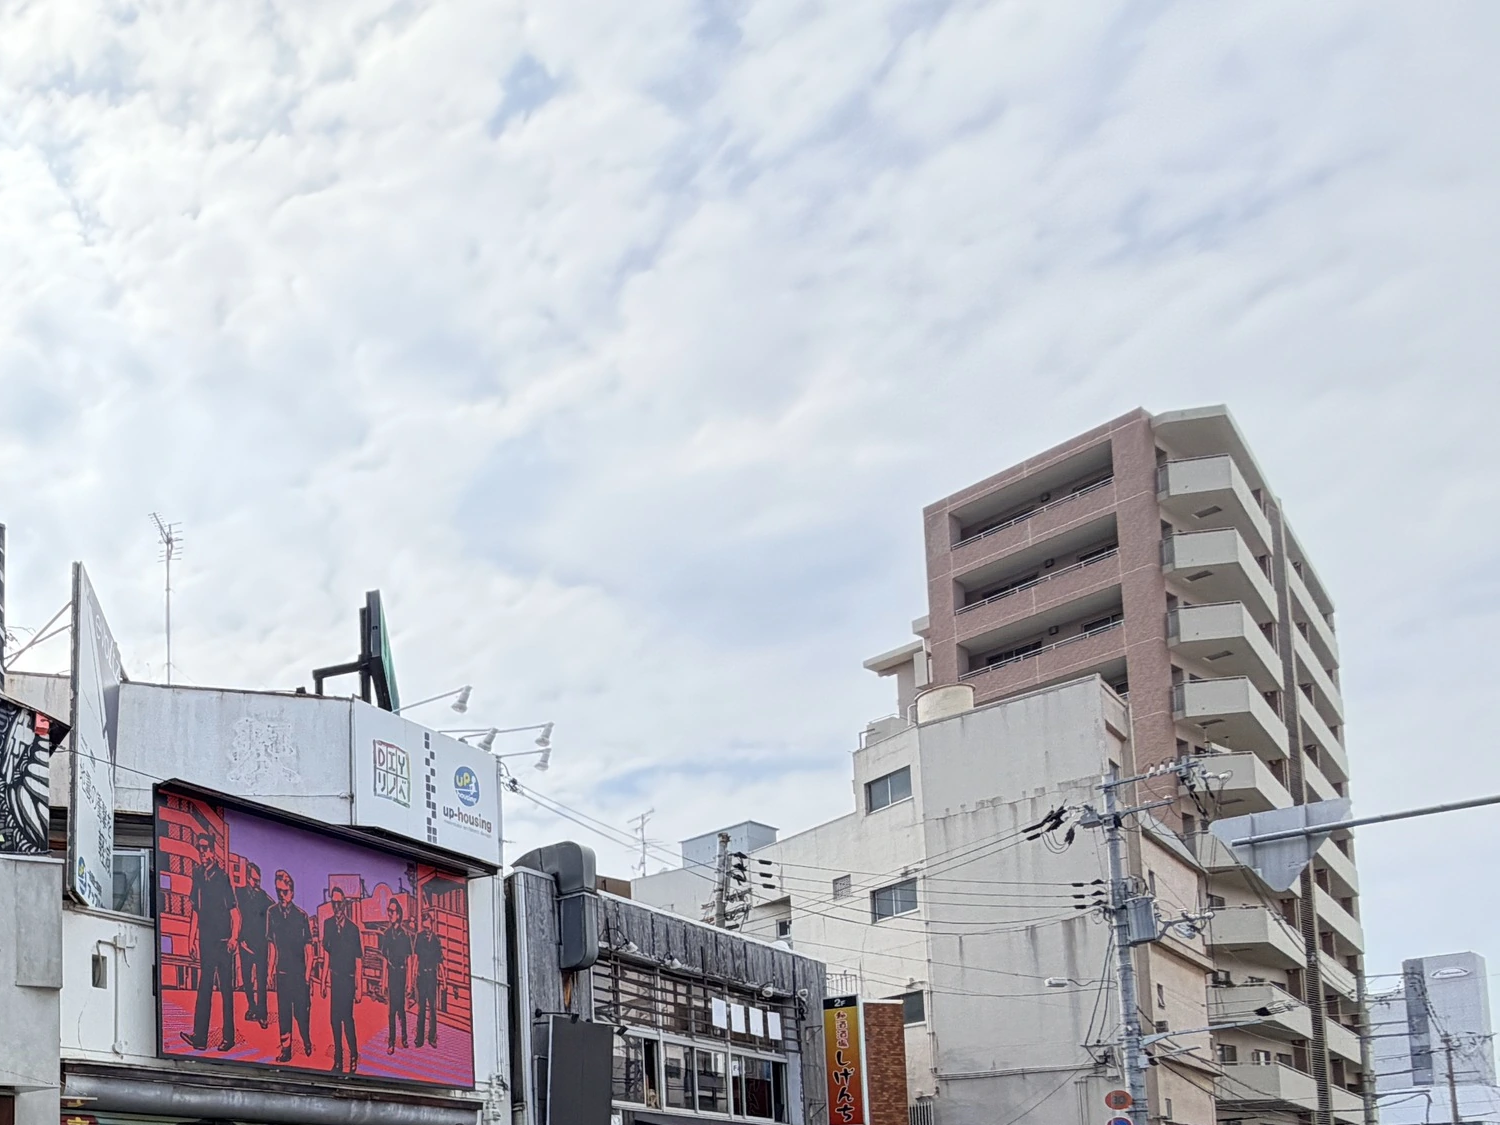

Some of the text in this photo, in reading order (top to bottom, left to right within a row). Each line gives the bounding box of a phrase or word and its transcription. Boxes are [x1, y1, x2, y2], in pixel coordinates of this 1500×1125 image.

[378, 747, 406, 775] DIY
[378, 771, 407, 800] リノベ
[443, 806, 492, 833] up-housing
[834, 999, 846, 1008] 2F
[833, 1050, 856, 1123] しげんち
